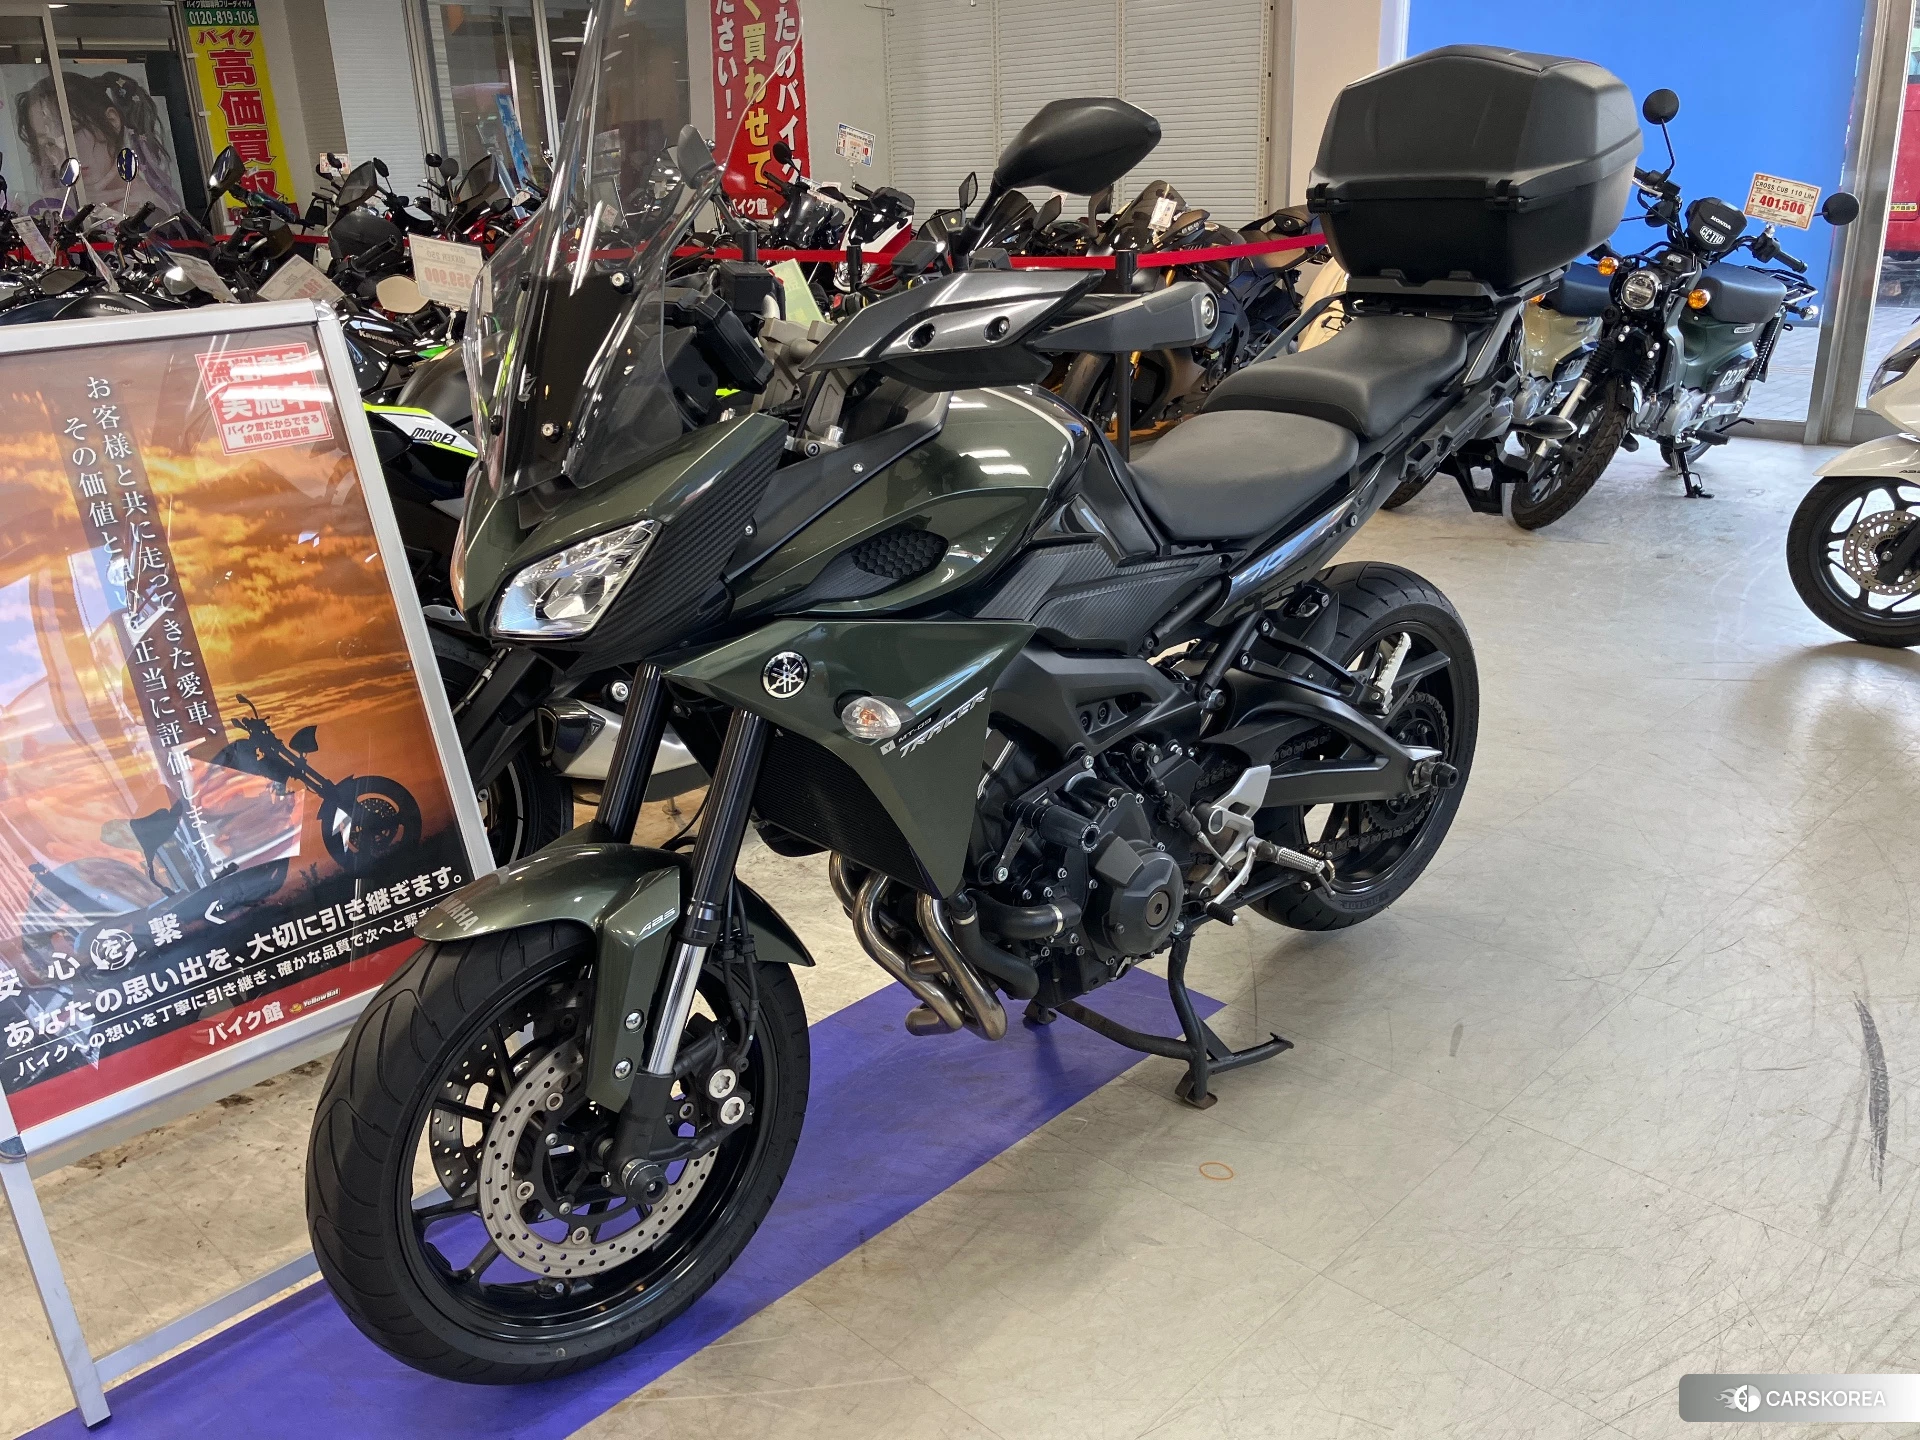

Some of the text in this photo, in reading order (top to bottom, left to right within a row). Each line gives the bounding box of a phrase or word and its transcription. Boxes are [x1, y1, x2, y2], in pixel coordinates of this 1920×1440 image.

[189, 10, 255, 25] 0120-819-106
[198, 28, 256, 46] バイク
[774, 0, 802, 186] たのバイク
[207, 48, 284, 201] 高価買取
[1755, 180, 1775, 191] CROSS
[1759, 194, 1806, 215] 401,500
[1710, 215, 1732, 230] HONDA
[358, 329, 400, 347] Kawasaki
[227, 414, 320, 435] バイク館だからできる
[243, 426, 310, 445] 納得の買取価格
[87, 376, 217, 735] お客様と共に走ってきた愛車、
[63, 417, 224, 867] その価値とい正当に評価します。
[898, 717, 932, 742] MT-09
[900, 686, 988, 758] TRACER
[638, 907, 676, 936] ABS
[3, 866, 462, 1048] あなたの思い出を、大切に引き継ぎます。
[18, 903, 438, 1077] バイクへの想いを丁寧に引き継ぎ、確かな品質で次へと繋ぎ
[208, 1001, 285, 1046] バイク館
